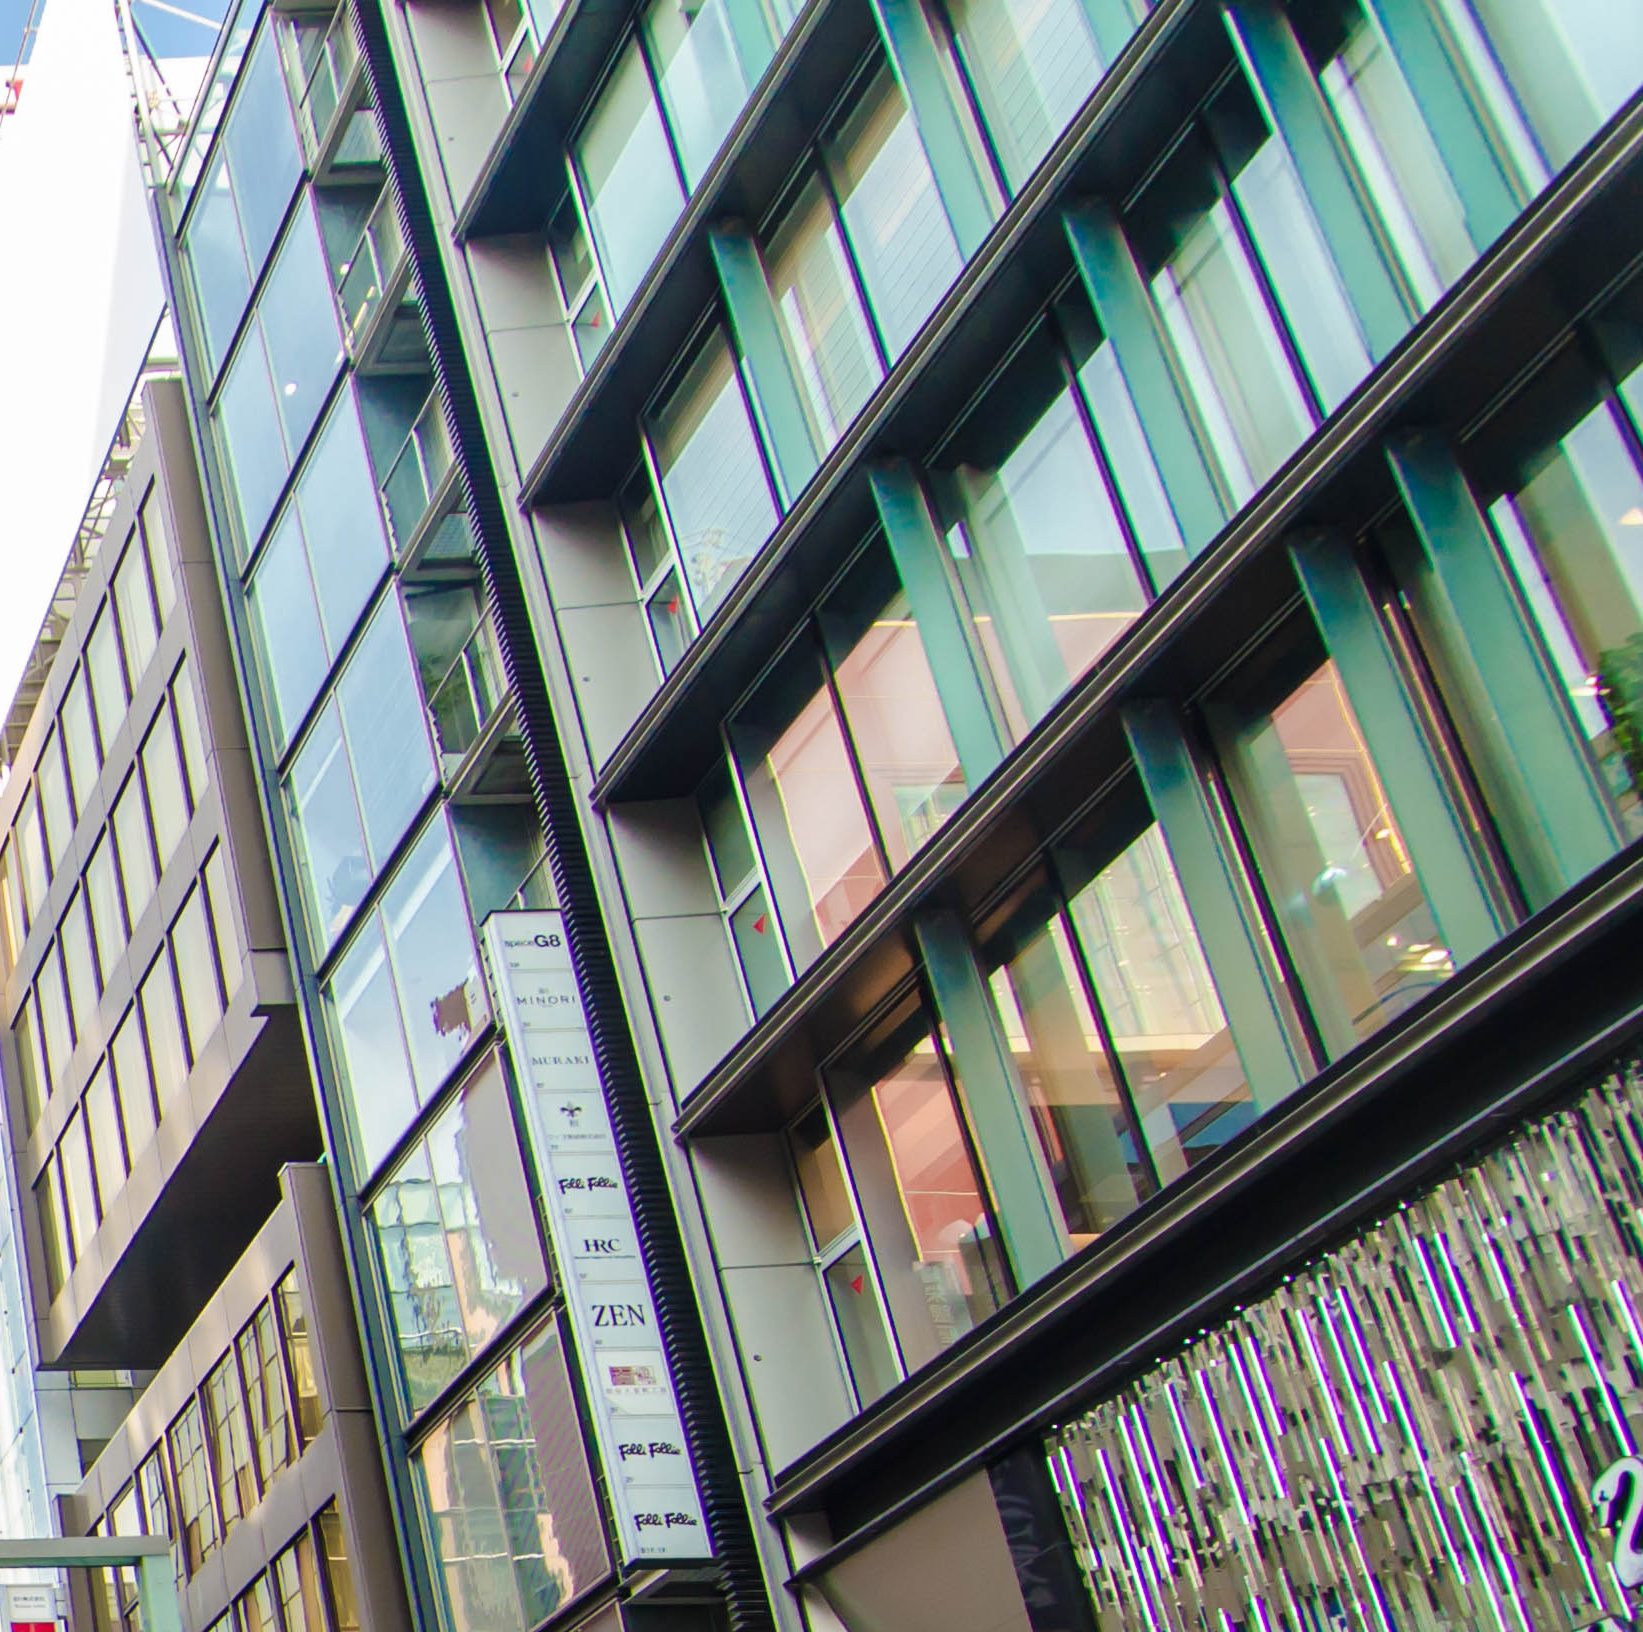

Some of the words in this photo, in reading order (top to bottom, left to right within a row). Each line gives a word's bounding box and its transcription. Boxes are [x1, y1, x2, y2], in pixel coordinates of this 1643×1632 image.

[558, 1178, 585, 1195] Folli
[584, 1239, 620, 1253] HRC
[592, 1304, 646, 1327] ZEN
[619, 1443, 647, 1462] Folli
[648, 1442, 682, 1459] Follie
[634, 1513, 664, 1532] Folli
[664, 1512, 698, 1529] Follie
